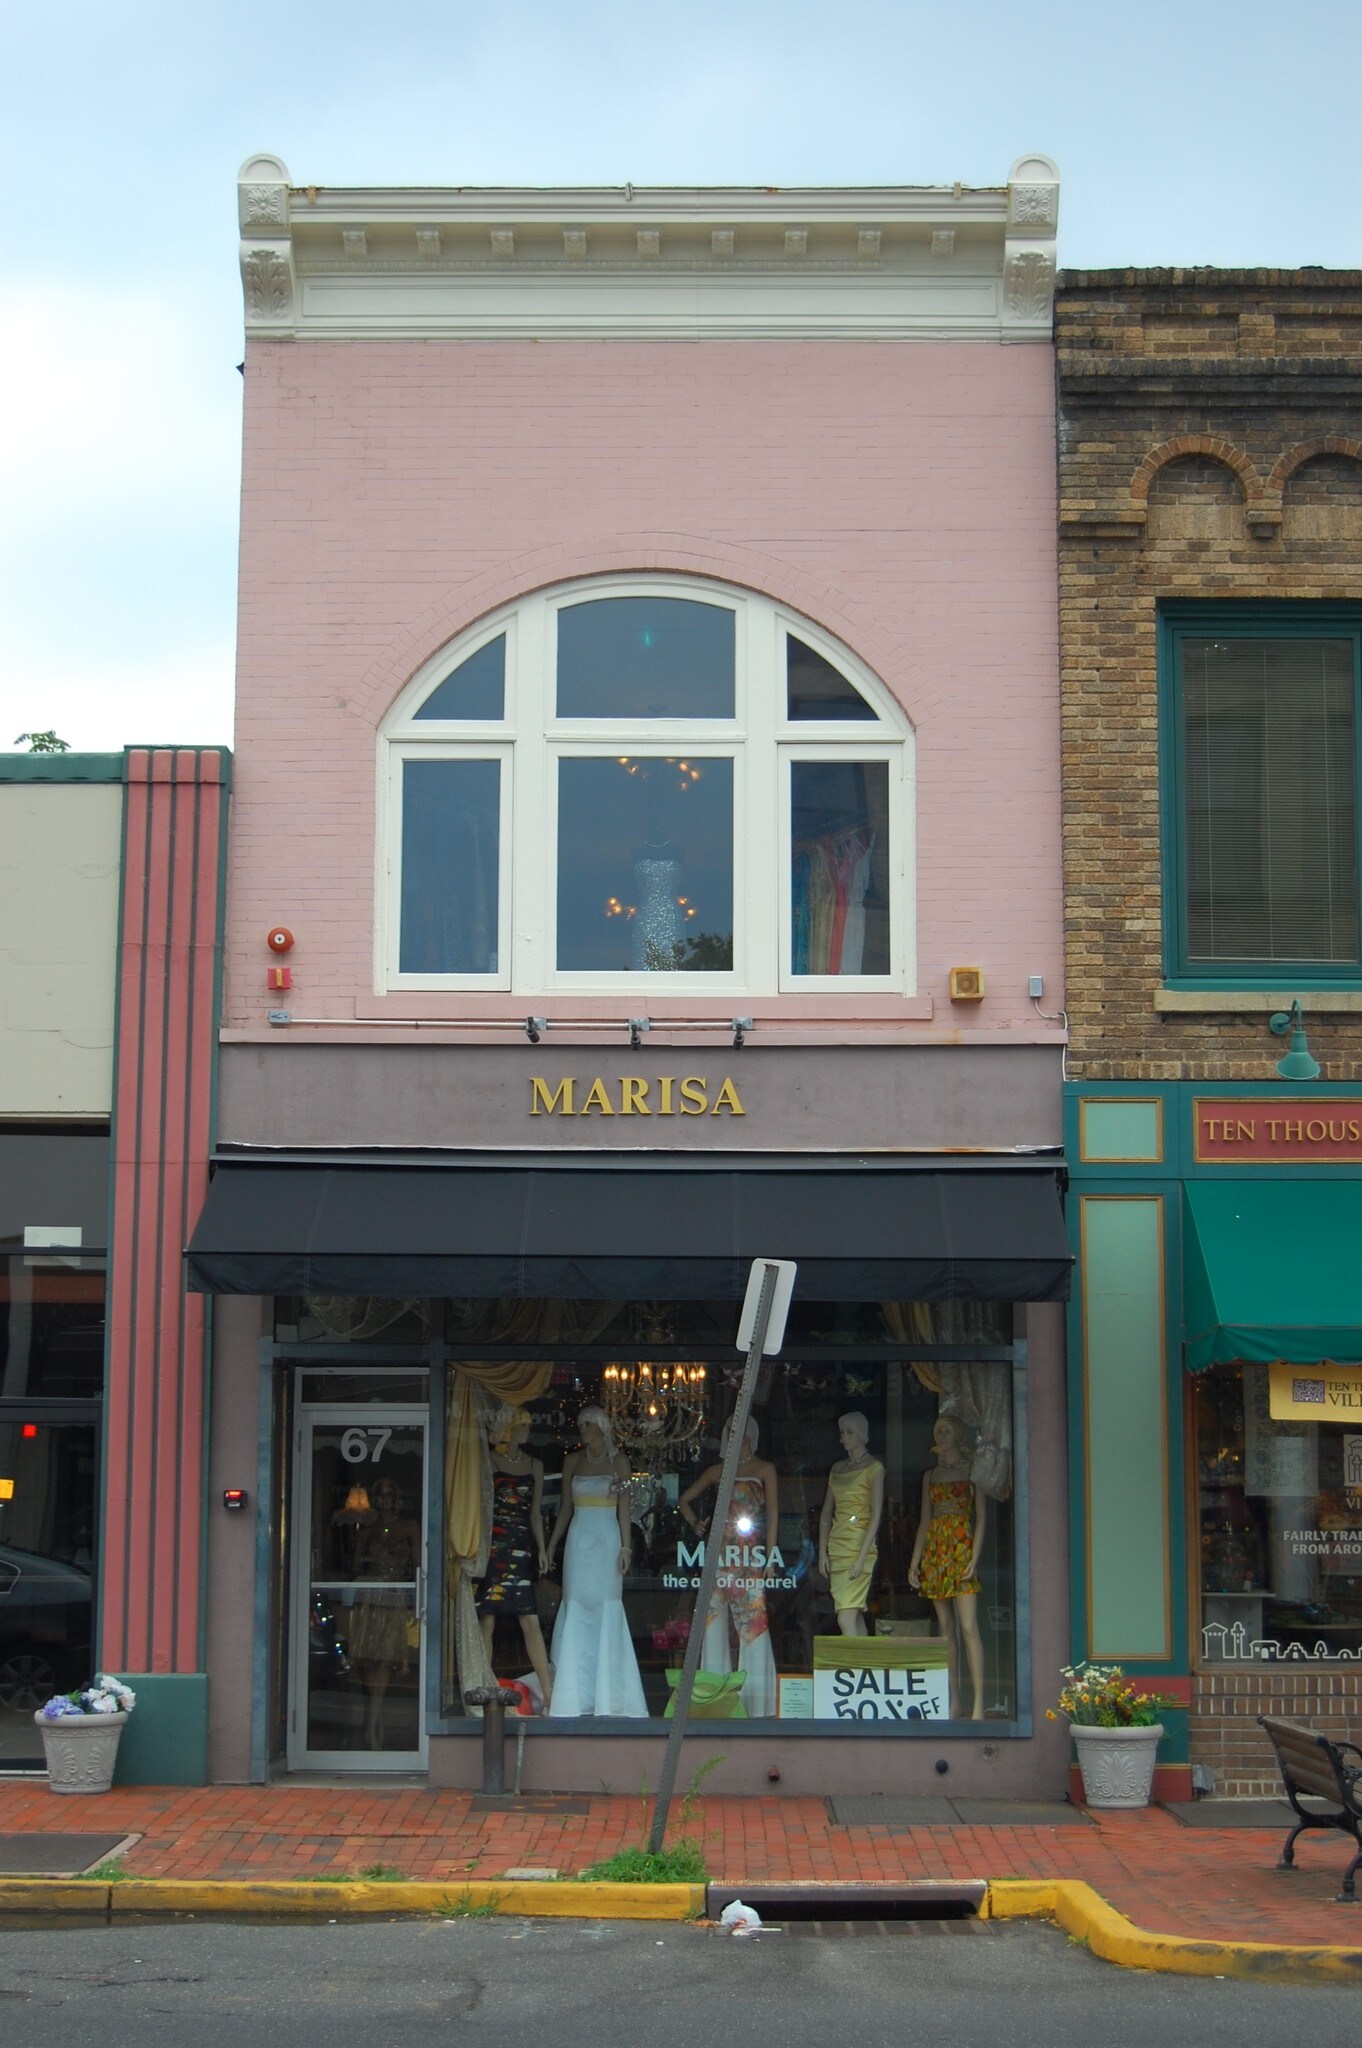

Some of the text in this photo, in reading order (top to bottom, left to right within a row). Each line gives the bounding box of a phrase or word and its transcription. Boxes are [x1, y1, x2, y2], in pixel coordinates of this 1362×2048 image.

[529, 1077, 746, 1115] MARISA
[1203, 1119, 1256, 1141] TEN
[1327, 1382, 1350, 1391] TEN
[1328, 1393, 1362, 1407] VIL
[341, 1427, 392, 1463] 67
[1283, 1530, 1328, 1541] FAIRLY
[1292, 1544, 1330, 1554] FROM
[663, 1574, 688, 1588] the
[716, 1574, 733, 1588] of
[735, 1575, 797, 1591] apparel
[833, 1668, 928, 1697] SALE
